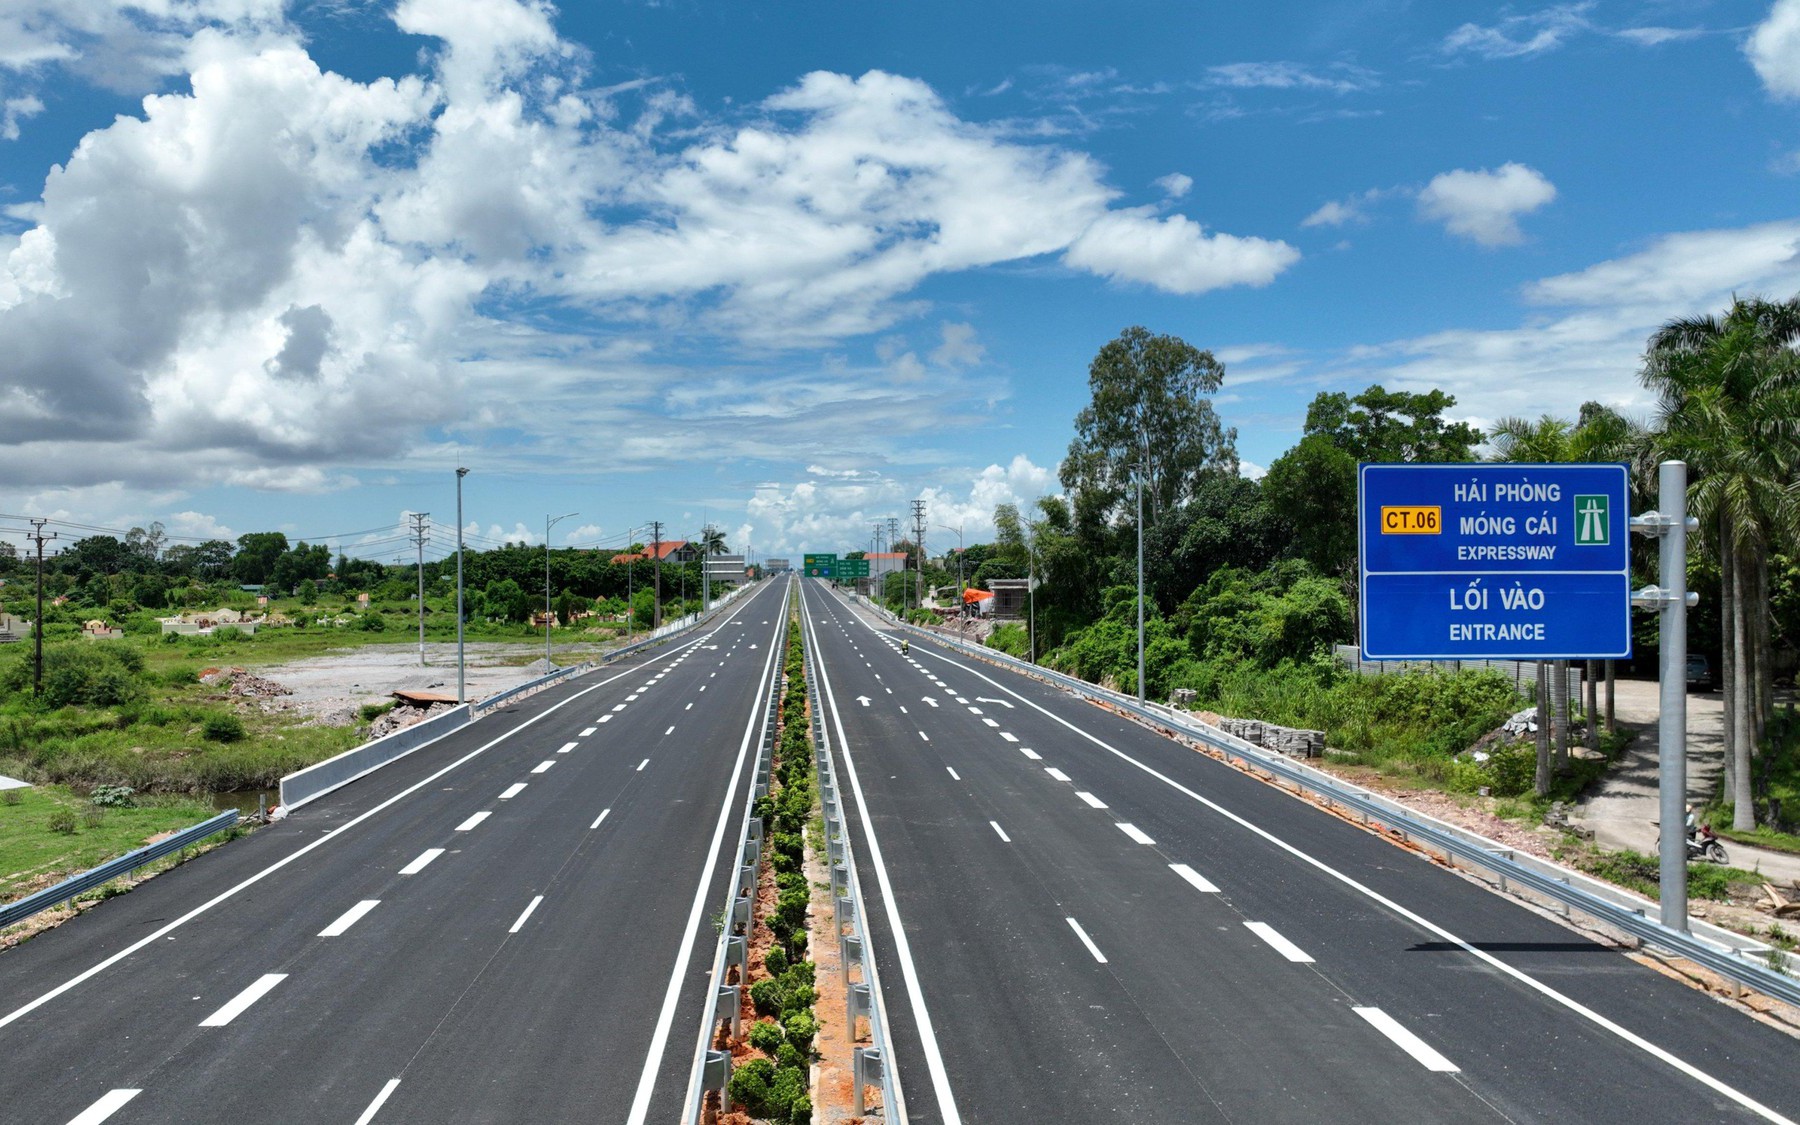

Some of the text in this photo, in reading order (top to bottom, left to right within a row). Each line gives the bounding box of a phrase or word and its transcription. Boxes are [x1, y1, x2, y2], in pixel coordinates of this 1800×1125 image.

[1455, 478, 1560, 501] HẢI PHÒNG
[1387, 512, 1436, 528] CT.06
[1461, 511, 1556, 534] MÓNG CÁI
[1458, 546, 1556, 559] EXPRESSWAY
[1450, 579, 1544, 609] LỐI VÀO
[1450, 624, 1544, 640] ENTRANCE
